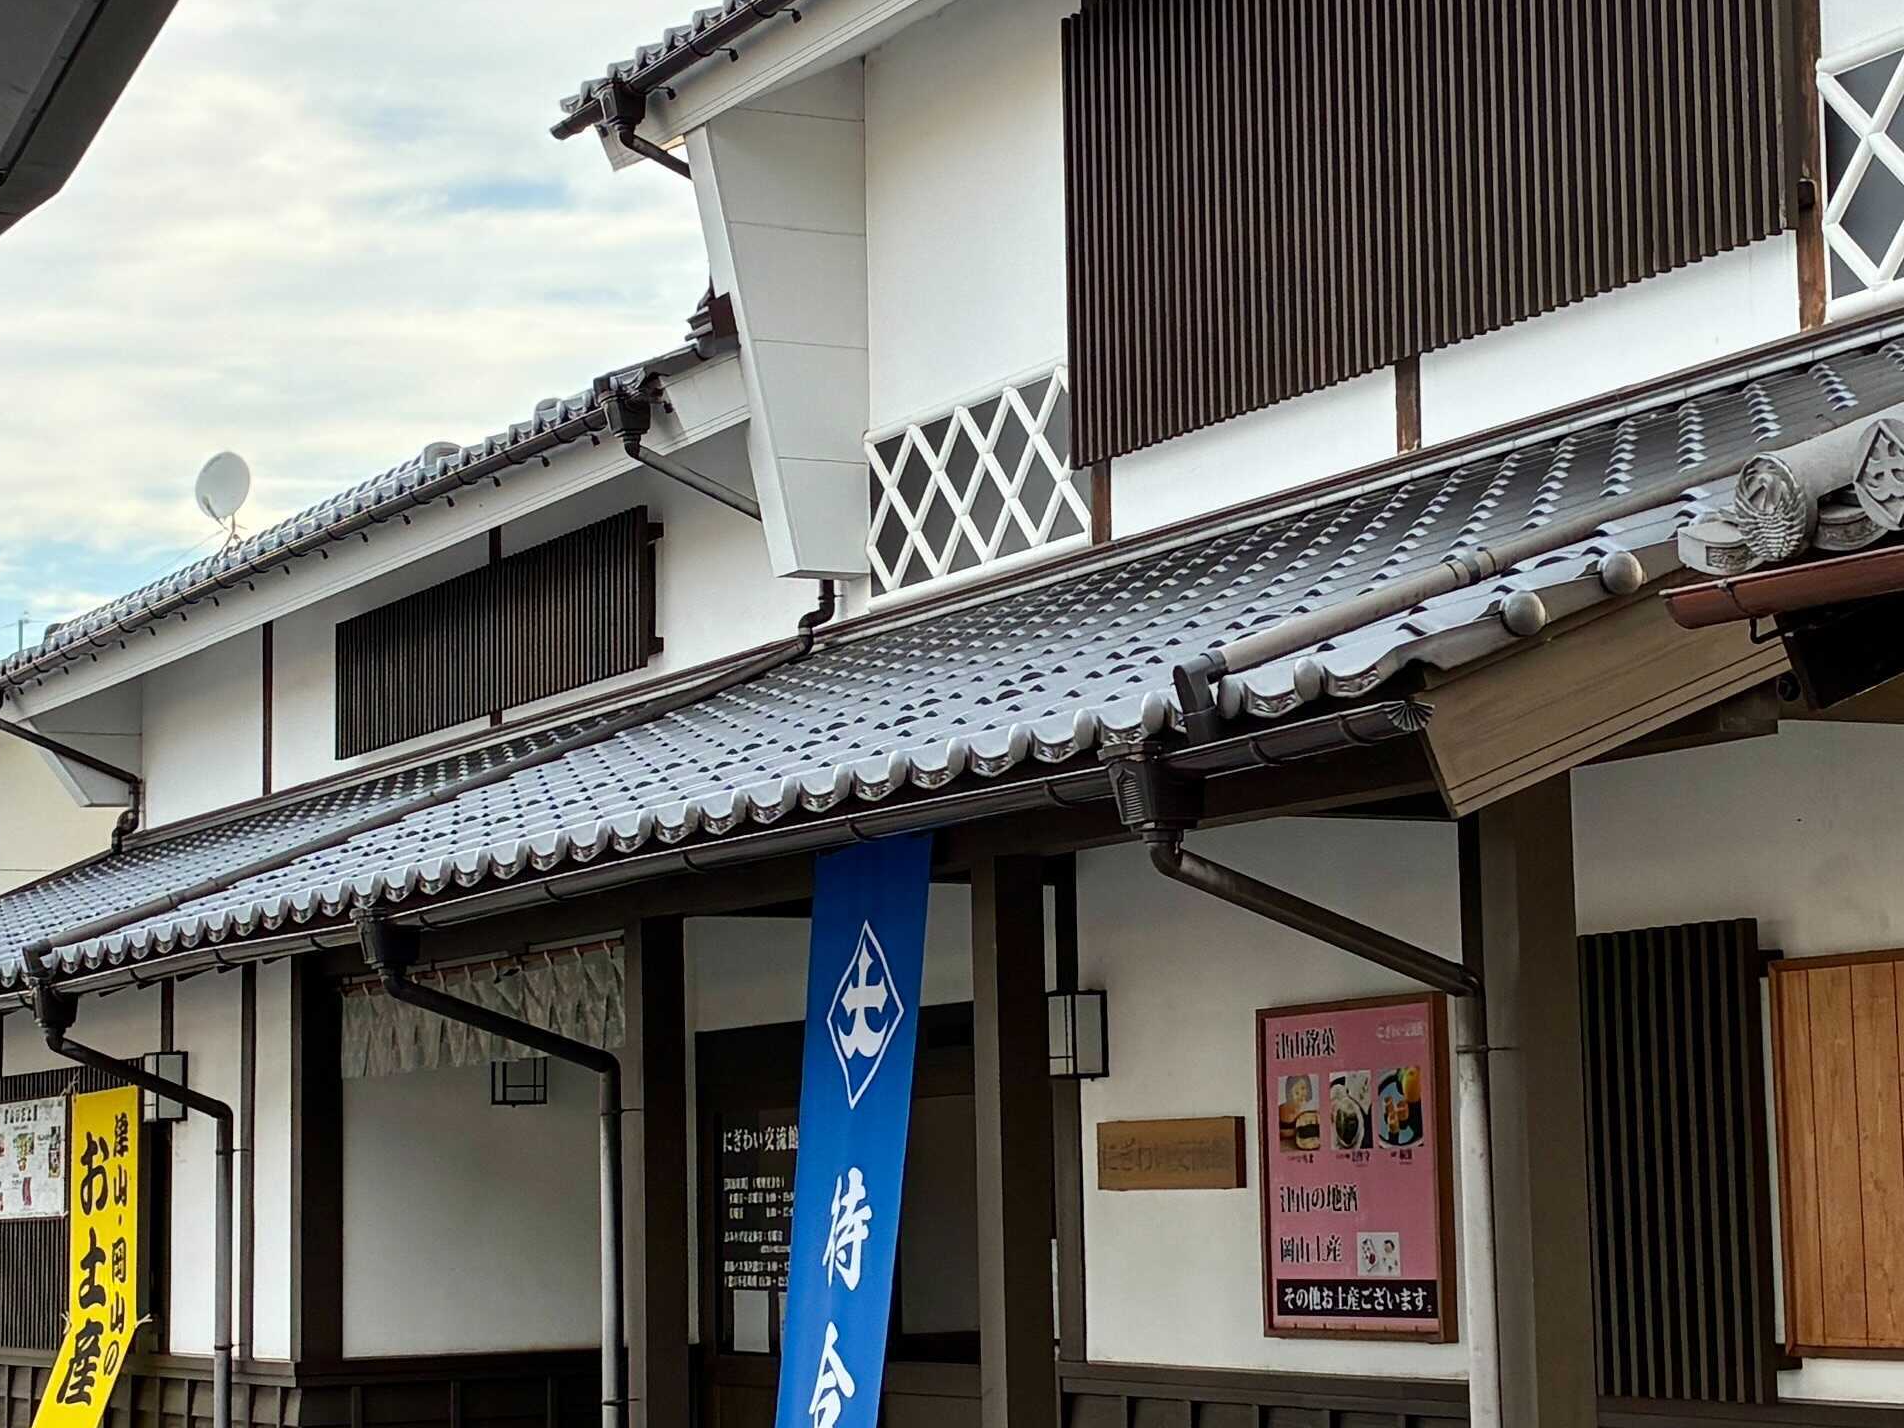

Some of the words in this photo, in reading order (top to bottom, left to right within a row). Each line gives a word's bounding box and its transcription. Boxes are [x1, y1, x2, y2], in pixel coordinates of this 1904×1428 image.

[1279, 1183, 1358, 1213] 津山の地酒
[103, 1112, 129, 1377] 津山・岡山の
[1280, 1234, 1343, 1263] 岡山土産
[56, 1130, 110, 1406] お土産
[1283, 1285, 1433, 1313] その他お土産ございます。
